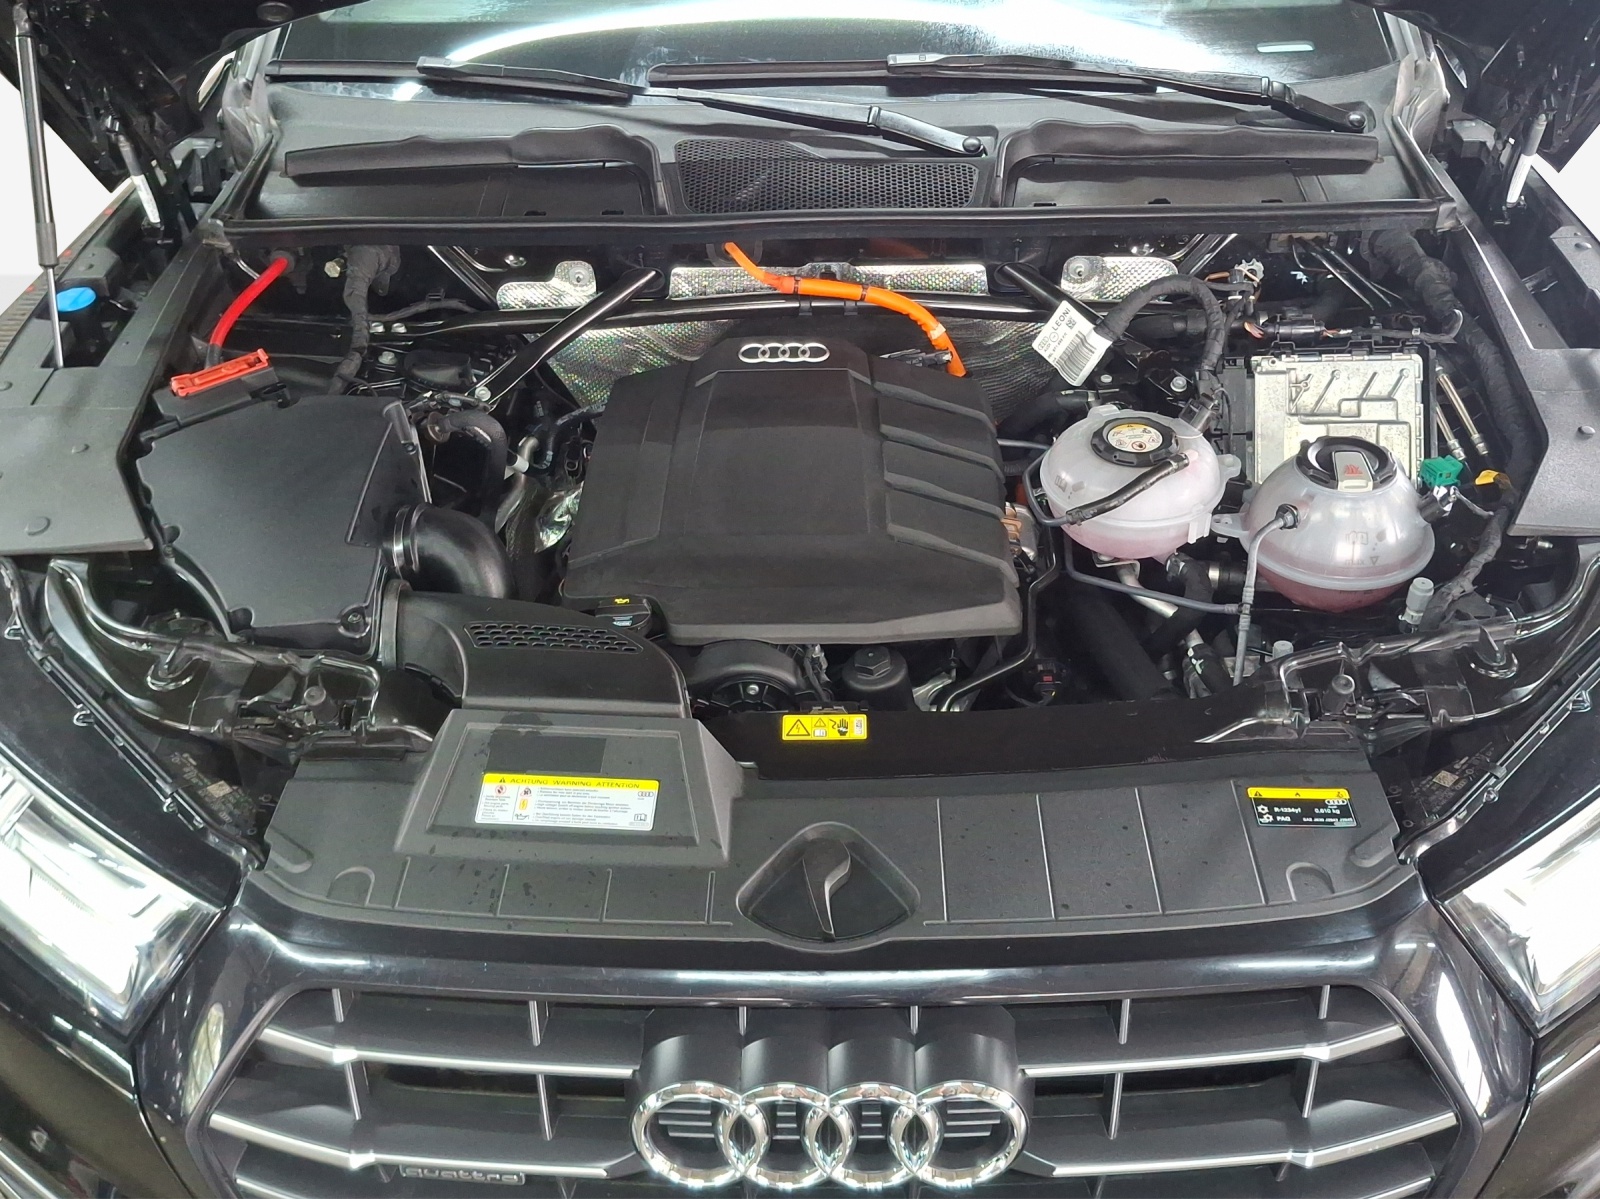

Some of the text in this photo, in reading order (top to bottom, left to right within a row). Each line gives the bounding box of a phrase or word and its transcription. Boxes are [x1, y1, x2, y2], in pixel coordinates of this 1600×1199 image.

[1052, 307, 1071, 331] LEONI
[596, 781, 640, 789] ATTENTION
[405, 1167, 519, 1183] quattro
